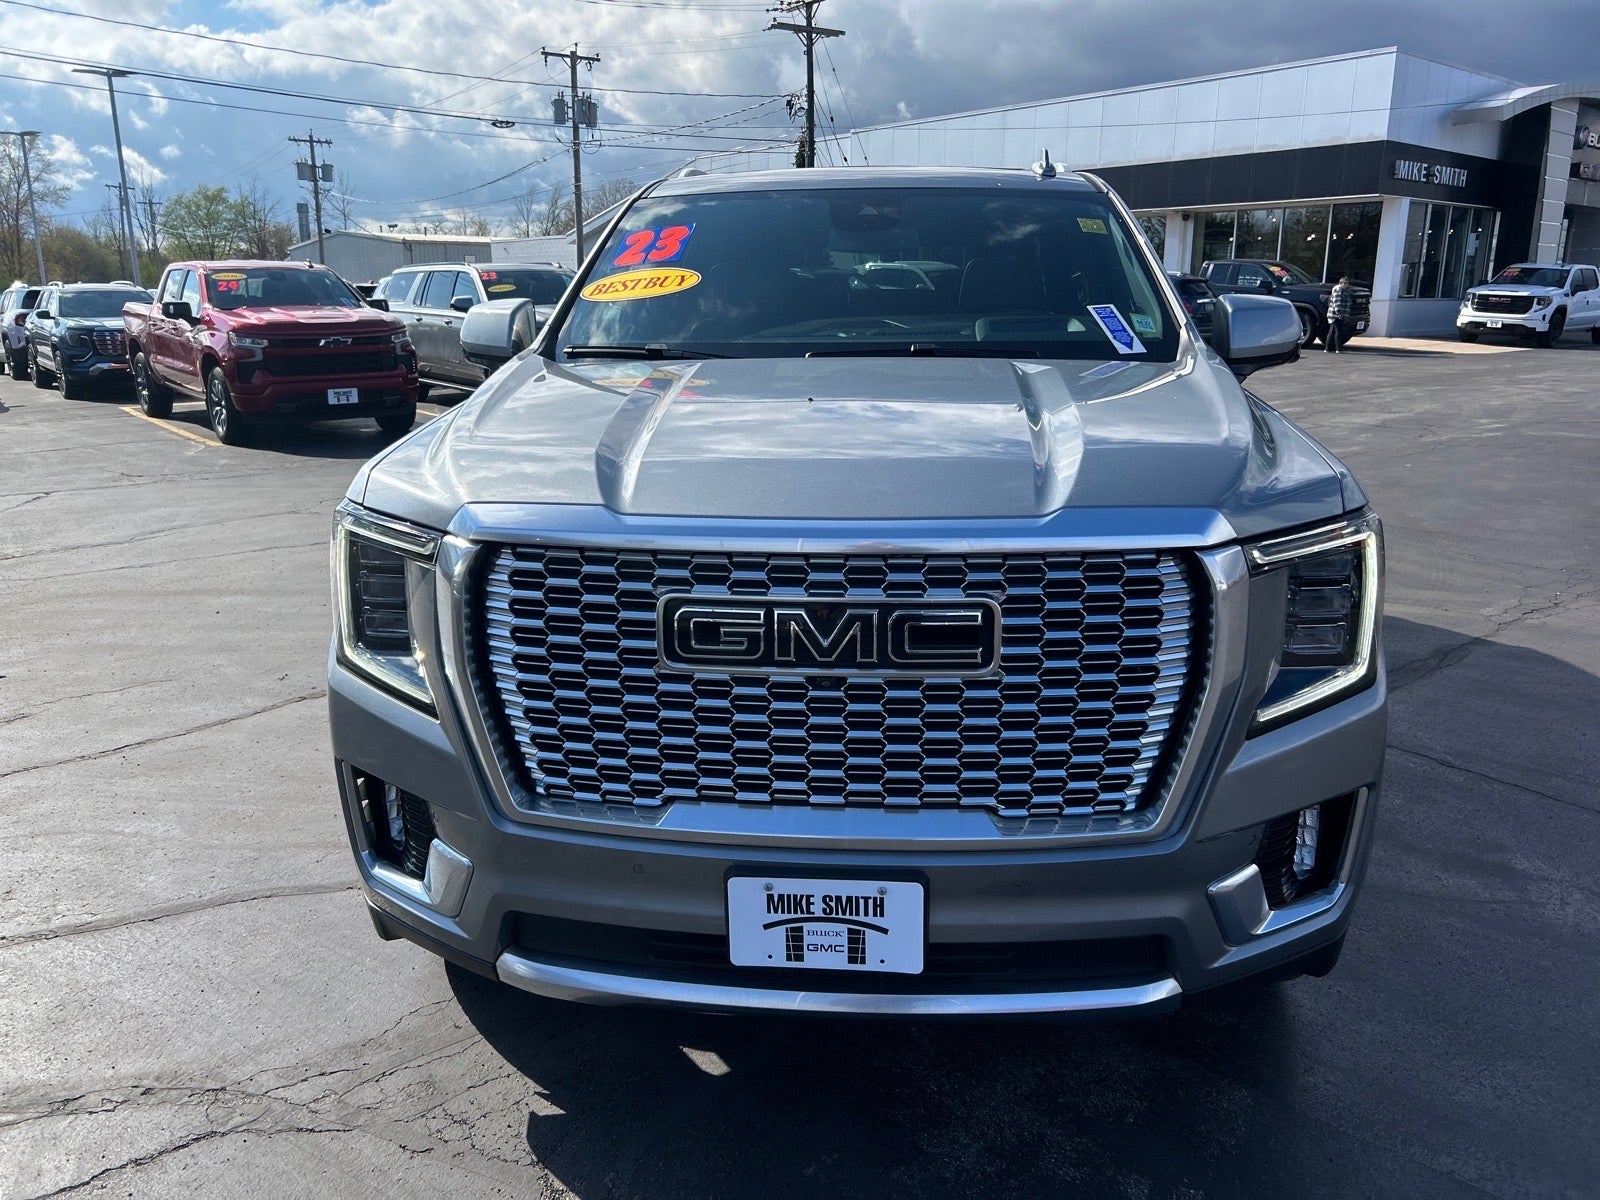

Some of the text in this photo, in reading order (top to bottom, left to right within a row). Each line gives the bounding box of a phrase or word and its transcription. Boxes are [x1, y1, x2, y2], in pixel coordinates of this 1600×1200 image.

[1396, 160, 1467, 187] MIKE SMITH
[613, 226, 689, 266] 23
[480, 271, 497, 281] 23
[217, 280, 239, 292] 24
[673, 606, 984, 664] GMC
[766, 893, 885, 917] MIKE SMITH
[806, 929, 844, 938] BUICK
[806, 943, 845, 953] GMC
